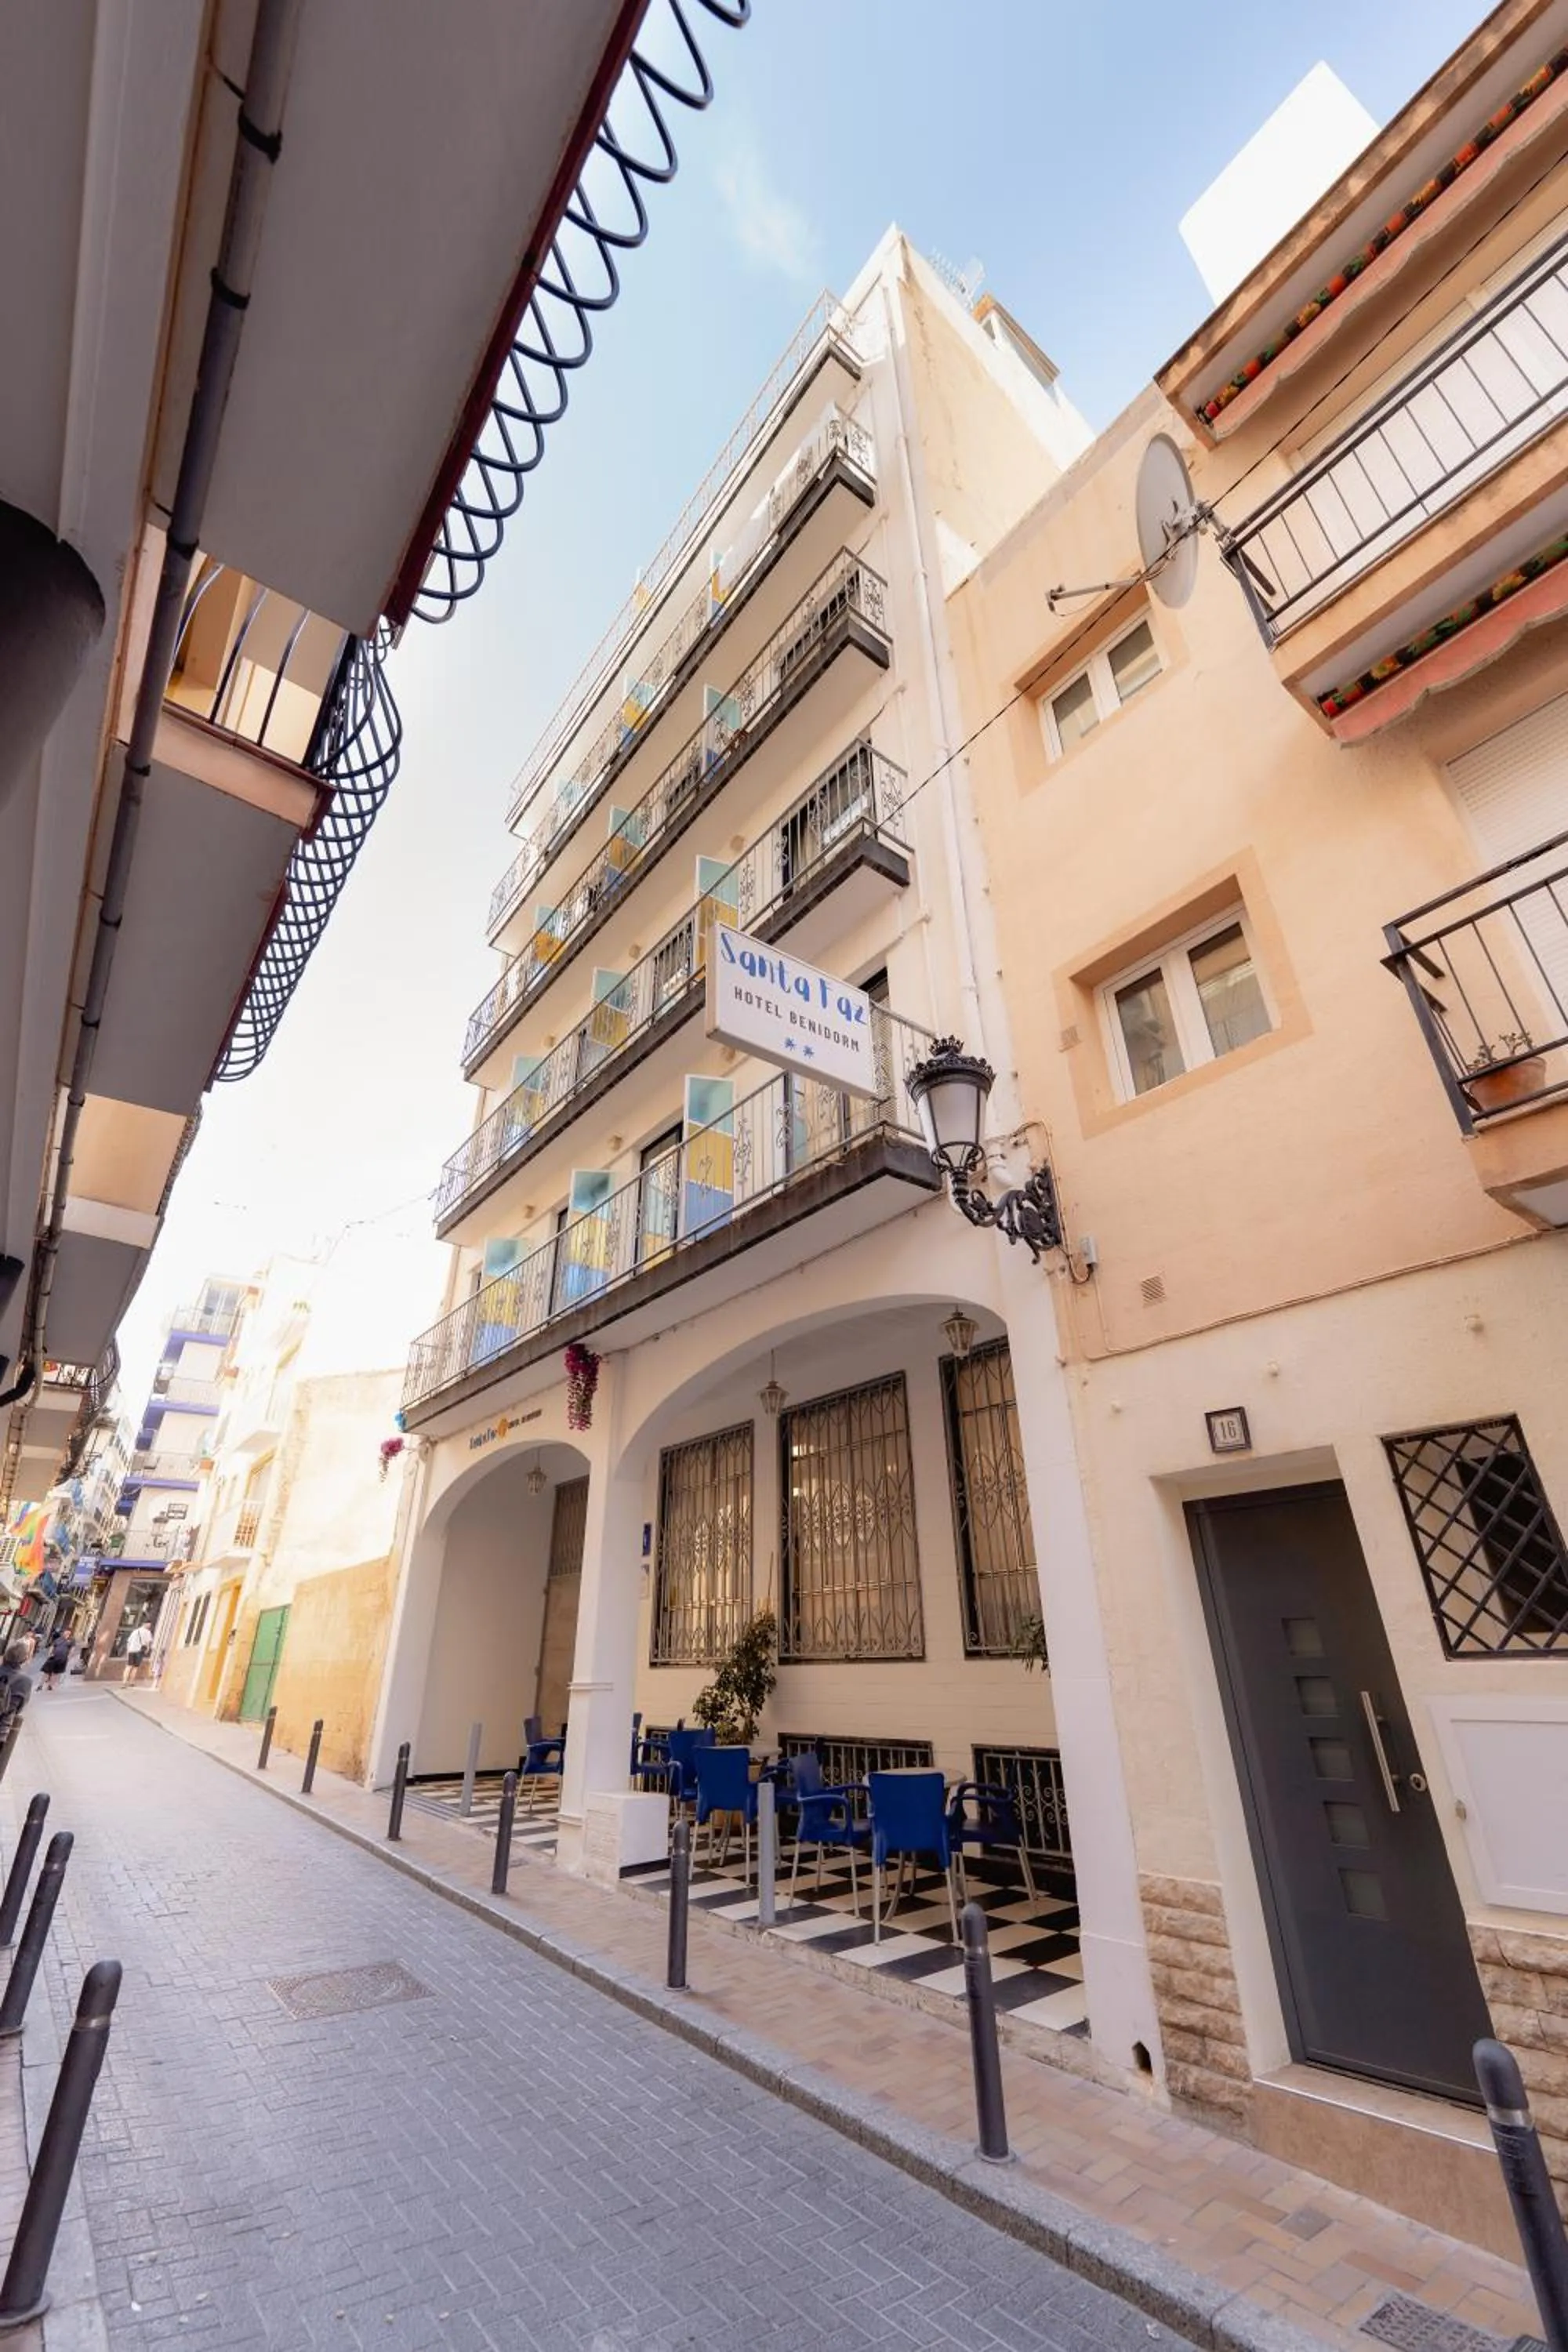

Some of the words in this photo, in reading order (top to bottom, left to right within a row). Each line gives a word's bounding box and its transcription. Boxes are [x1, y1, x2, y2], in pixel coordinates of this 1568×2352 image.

[720, 931, 811, 1003] Santa
[734, 985, 782, 1019] HOTEL
[789, 1011, 861, 1053] BENIDORM
[1220, 1420, 1236, 1440] 16
